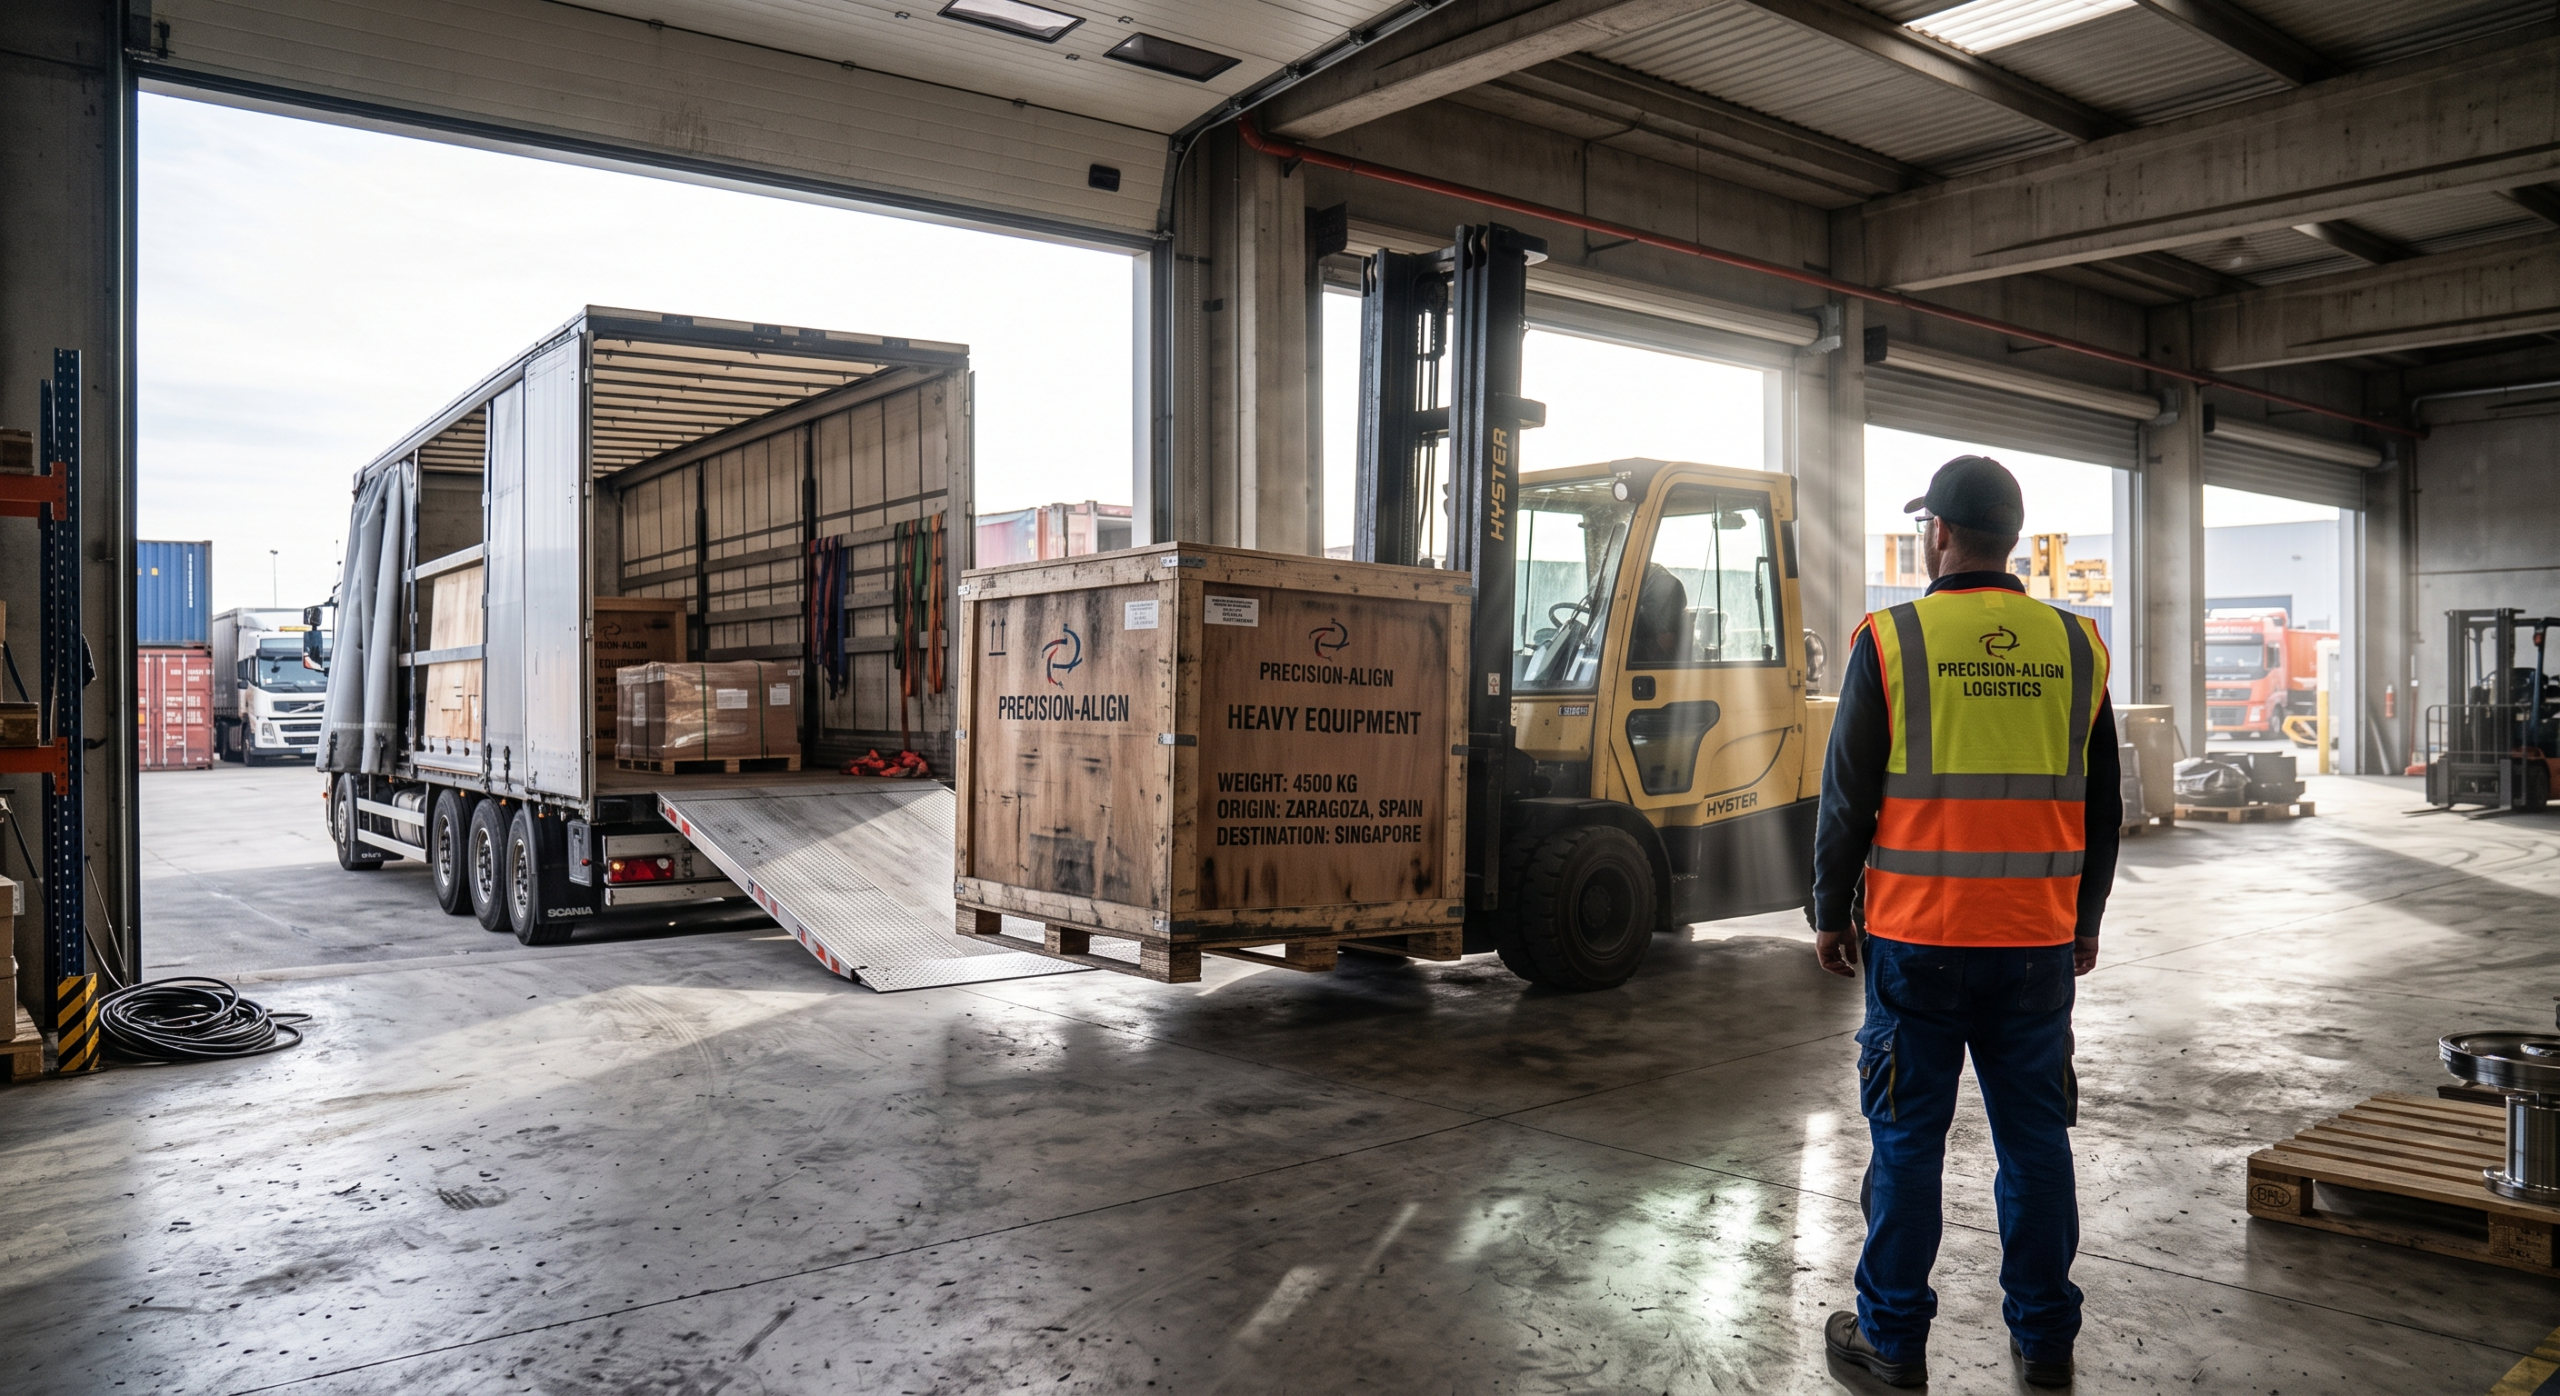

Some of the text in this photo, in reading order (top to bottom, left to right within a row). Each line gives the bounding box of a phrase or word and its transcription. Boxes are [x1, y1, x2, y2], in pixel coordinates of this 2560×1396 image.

[1490, 427, 1507, 541] HYSTER
[1259, 662, 1394, 688] PRECISION-ALIGN
[1937, 662, 2064, 679] PRECISION-ALIGN
[1963, 681, 2042, 697] LOGISTICS
[998, 694, 1129, 722] PRECISION-ALIGN
[1227, 704, 1422, 735] HEAVY EQUIPMENT
[1217, 772, 1358, 793] WEIGHT: 4500 KG
[1217, 799, 1423, 821] ORIGIN: ZARAGOZA, SPAIN
[1216, 825, 1422, 846] DESTINATION: SINGAPORE
[547, 906, 593, 918] SCANIA
